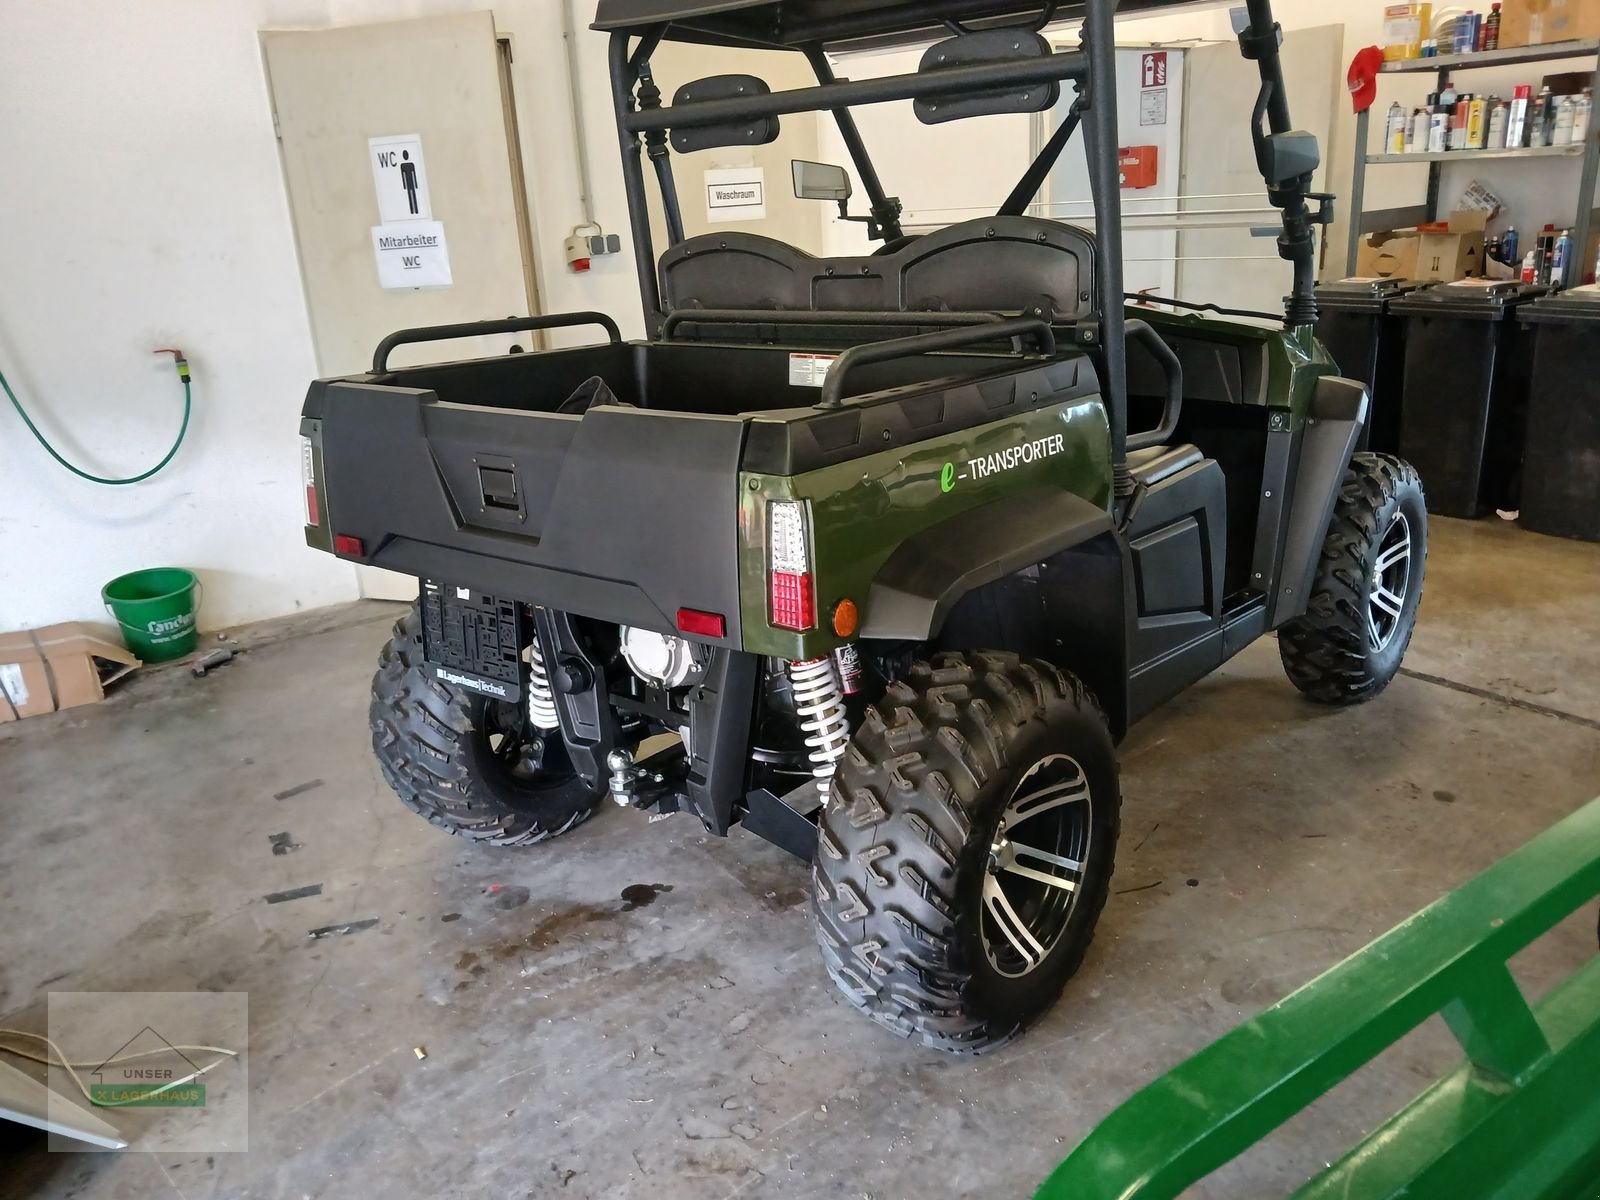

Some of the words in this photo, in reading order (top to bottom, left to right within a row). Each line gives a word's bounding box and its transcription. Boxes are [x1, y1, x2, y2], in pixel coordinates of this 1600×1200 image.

[377, 151, 398, 169] WC
[715, 190, 755, 200] Waschraum
[379, 234, 438, 250] Mitarbeiter
[402, 255, 421, 268] WC
[940, 462, 956, 493] e
[967, 433, 1065, 480] TRANSPORTER
